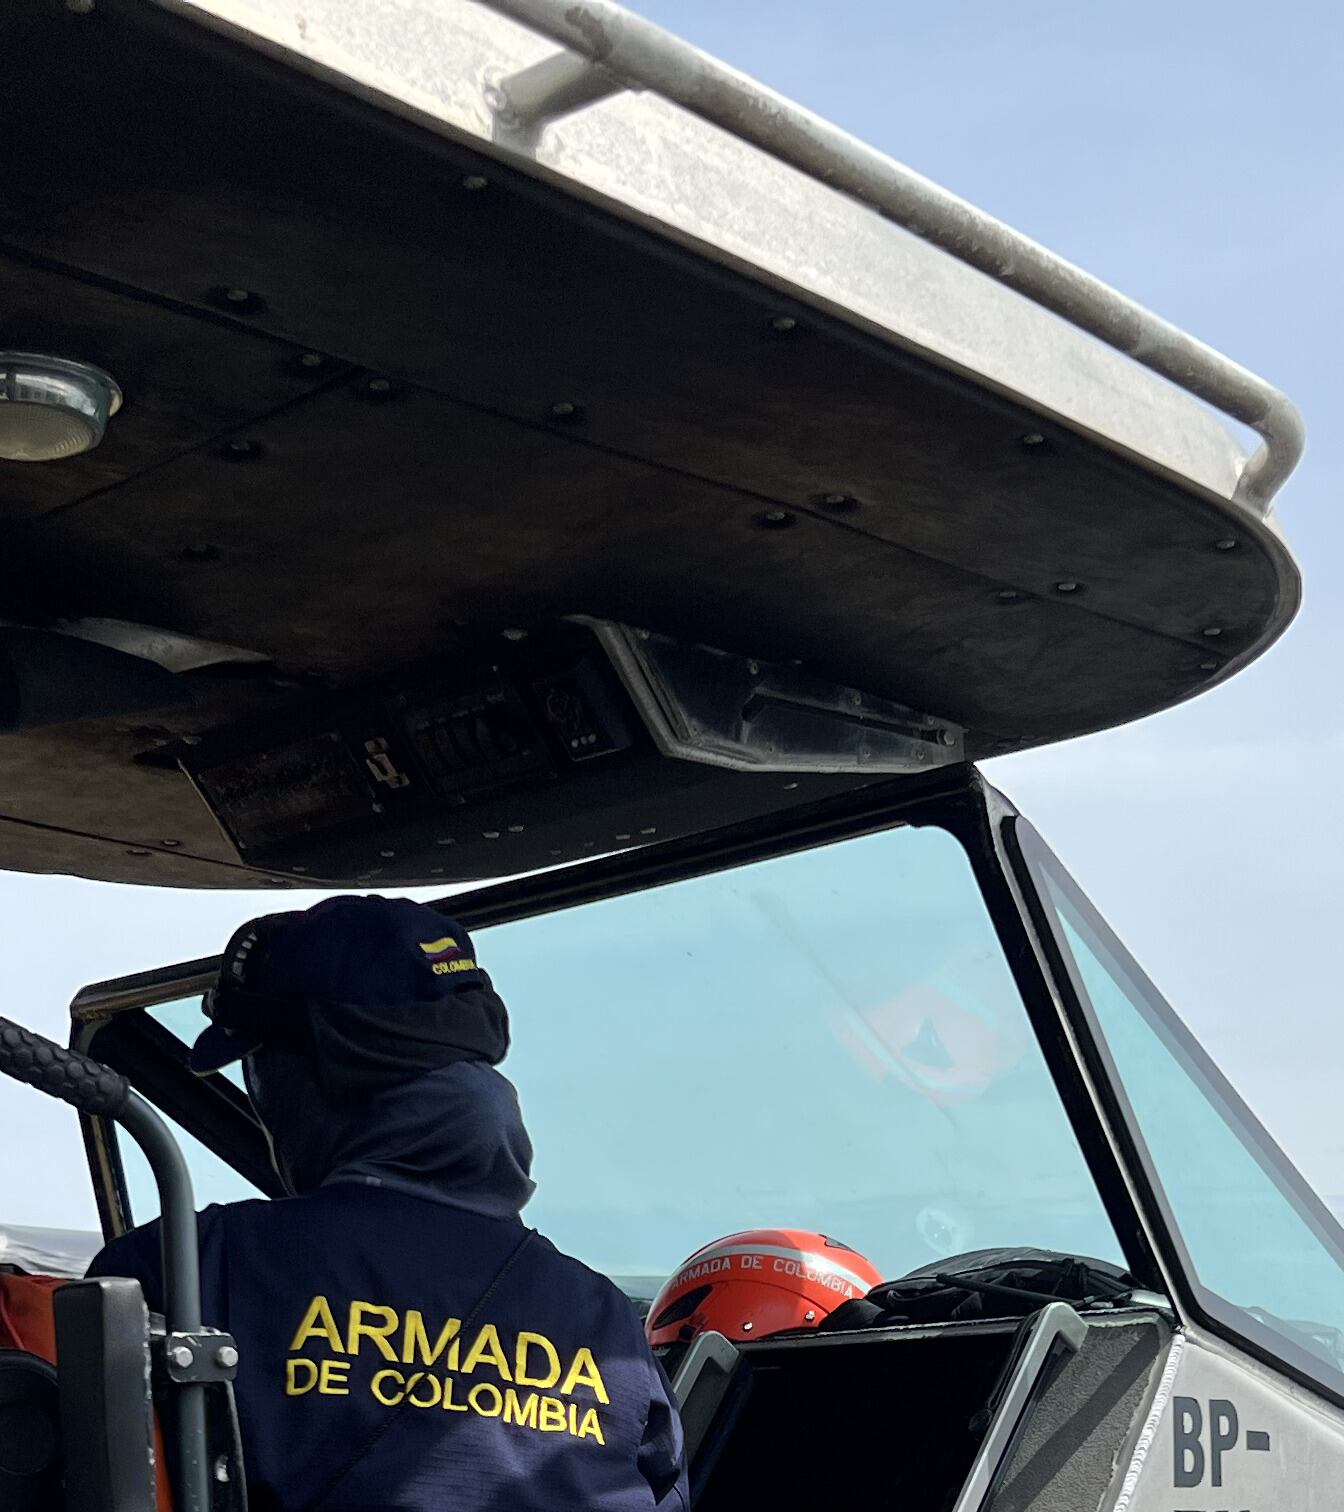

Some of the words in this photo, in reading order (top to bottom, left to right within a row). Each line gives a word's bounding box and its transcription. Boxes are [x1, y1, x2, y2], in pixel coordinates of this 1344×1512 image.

[671, 1256, 731, 1289] ARMADA
[741, 1255, 763, 1269] DE
[773, 1258, 855, 1299] COLOMBIA
[288, 1295, 610, 1405] ARMADA
[285, 1357, 350, 1396] DE
[370, 1368, 605, 1446] COLOMBIA
[1172, 1396, 1271, 1488] BP-
